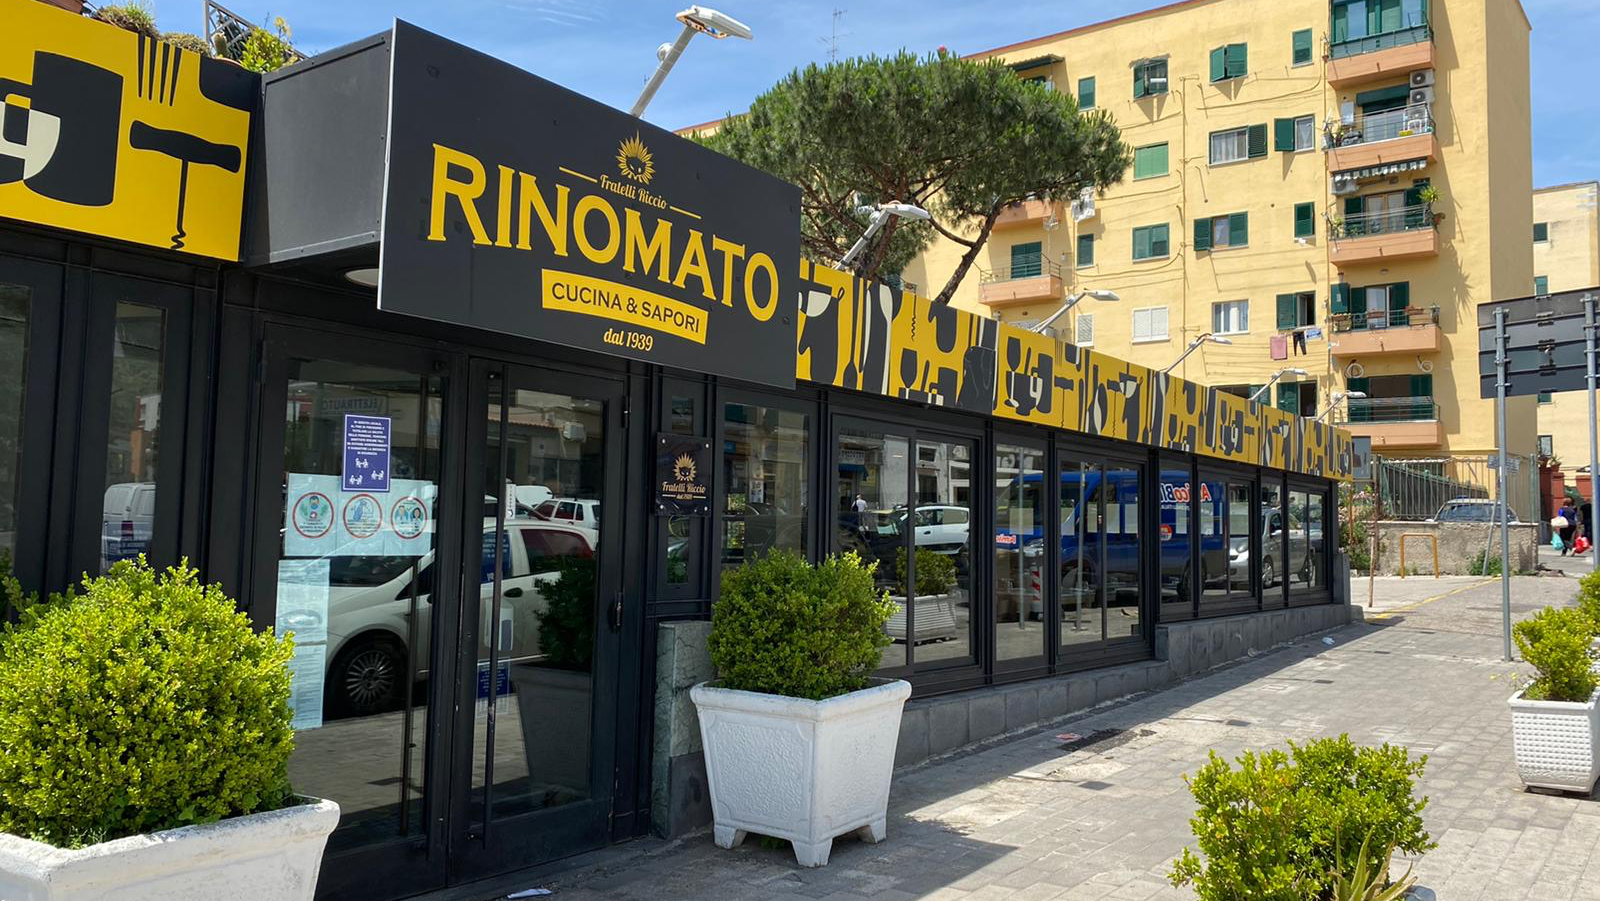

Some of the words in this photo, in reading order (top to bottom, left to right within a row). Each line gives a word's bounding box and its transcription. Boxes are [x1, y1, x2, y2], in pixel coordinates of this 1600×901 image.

[601, 175, 637, 199] Fratelli
[638, 189, 667, 209] Riccio
[427, 142, 780, 322] RINOMATO
[551, 282, 622, 311] CUCINA
[626, 299, 638, 315] &
[641, 302, 700, 333] SAPORI
[603, 327, 624, 345] dal
[626, 332, 654, 352] 1939
[662, 482, 685, 491] Fratelli
[686, 484, 705, 493] Riccio
